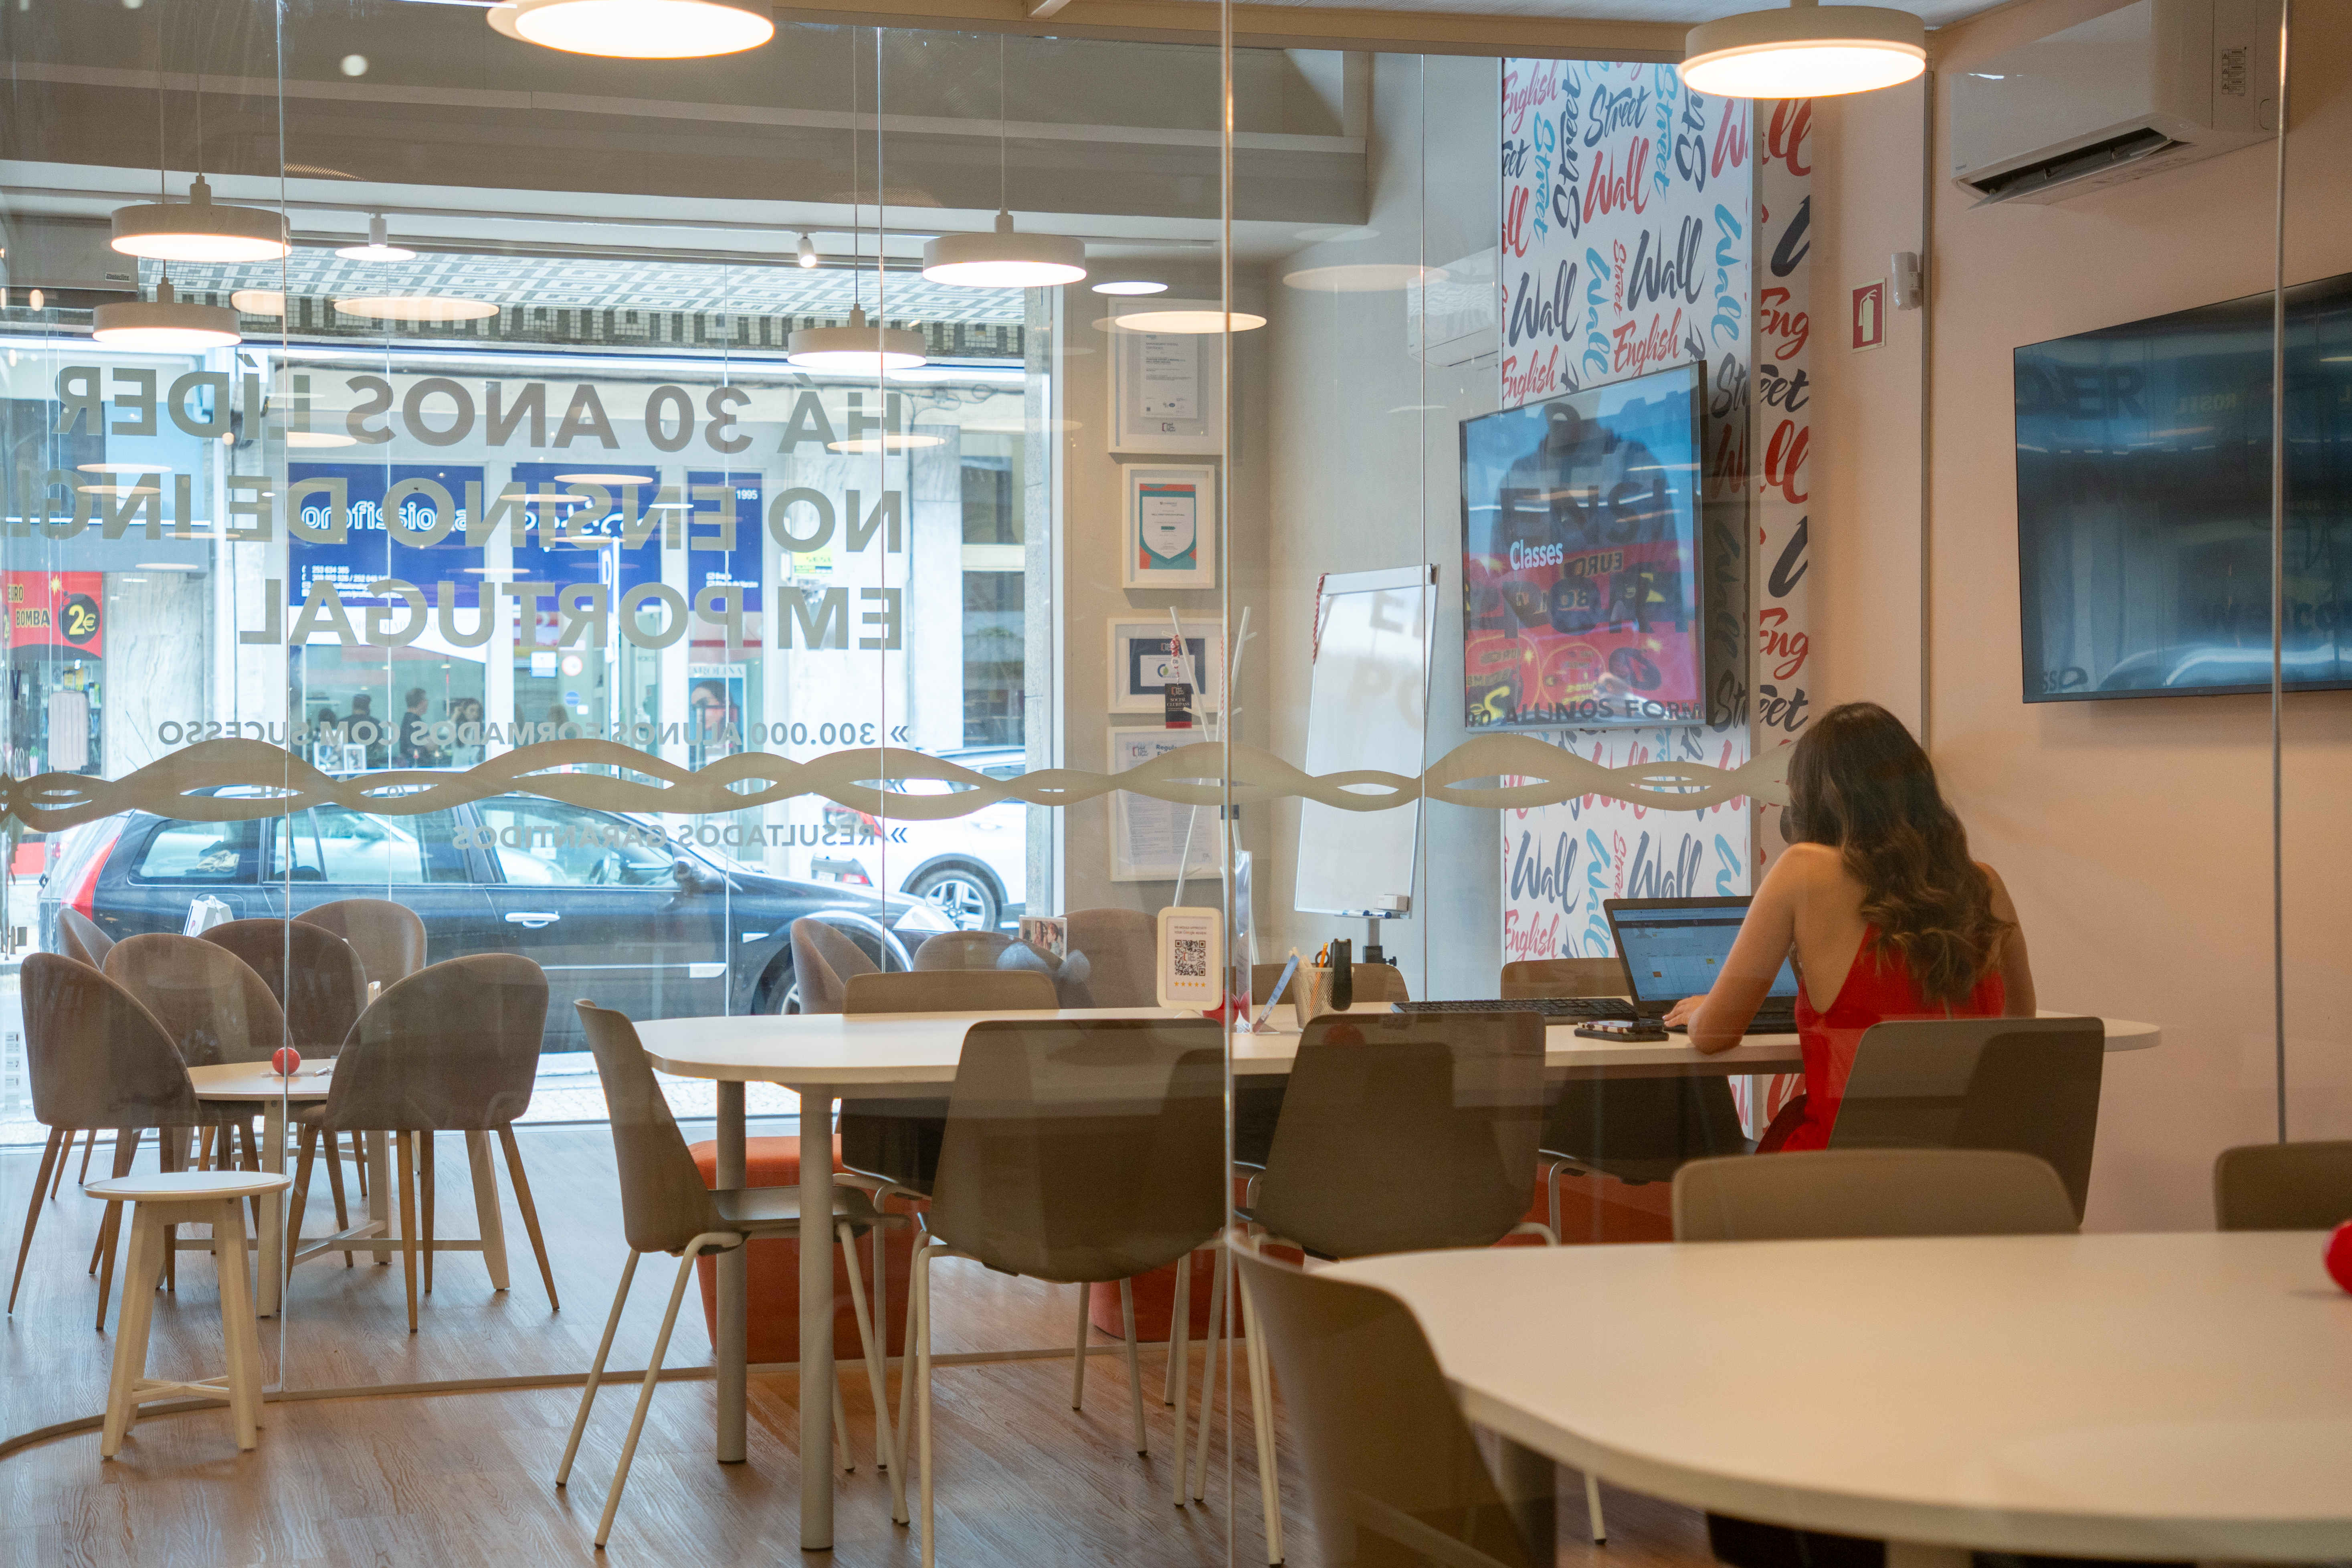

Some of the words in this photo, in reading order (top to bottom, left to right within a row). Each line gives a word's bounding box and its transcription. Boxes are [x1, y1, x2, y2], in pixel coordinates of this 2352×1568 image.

[1584, 84, 1653, 147] Street
[1534, 111, 1556, 247] Street
[1584, 135, 1651, 223] Wall
[1509, 259, 1580, 347] Wall
[1612, 238, 1627, 319] Street
[1627, 215, 1706, 311] Wall
[1711, 204, 1742, 349] Wall
[1582, 247, 1611, 382] Wall
[1612, 307, 1681, 378] English
[736, 489, 758, 500] 1995
[1510, 539, 1563, 570] Classes
[16, 608, 50, 628] BOMBA
[69, 604, 96, 635] 2€
[689, 667, 743, 675] AROLINA
[1511, 830, 1580, 914] Wall
